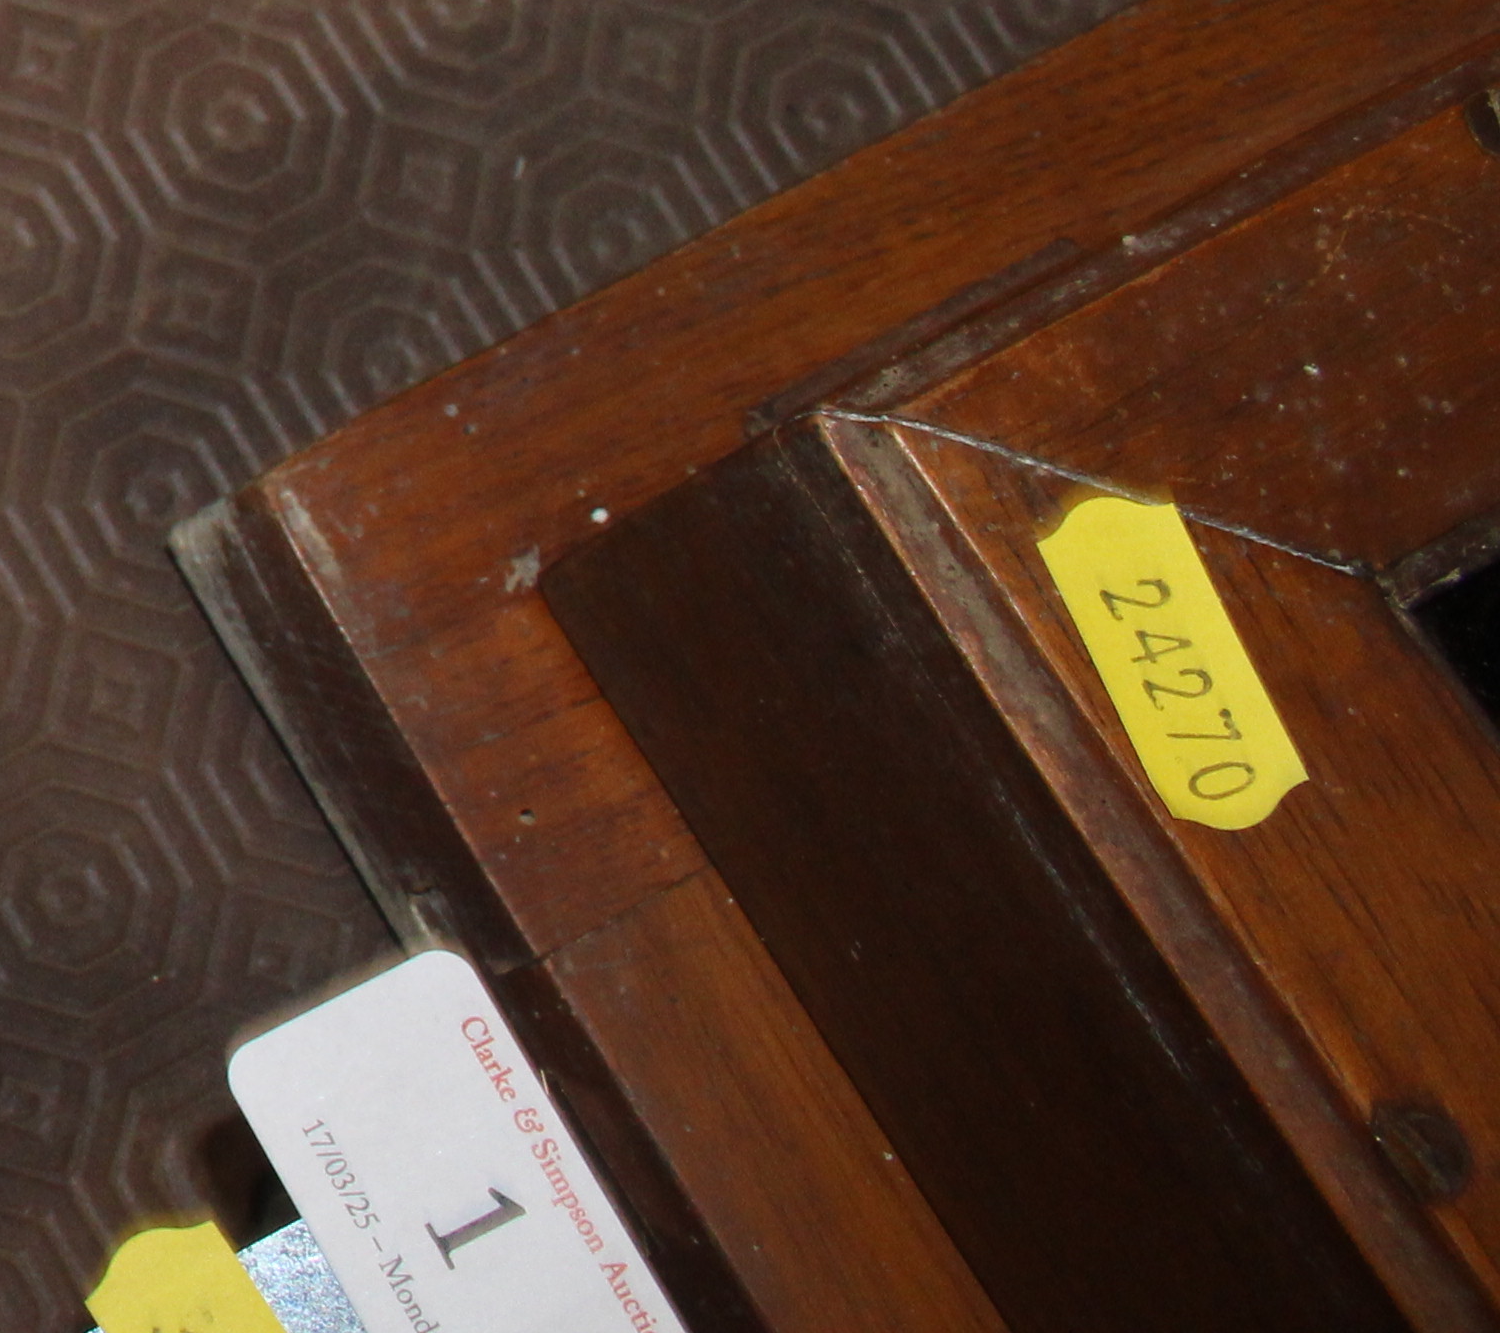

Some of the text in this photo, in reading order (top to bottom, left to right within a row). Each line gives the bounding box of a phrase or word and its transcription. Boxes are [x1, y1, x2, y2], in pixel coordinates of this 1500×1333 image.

[1099, 578, 1257, 801] 24270
[302, 1119, 381, 1229] 17/03/25
[425, 1187, 526, 1270] 1
[460, 1016, 657, 1333] Clarke & Simpson Aucti
